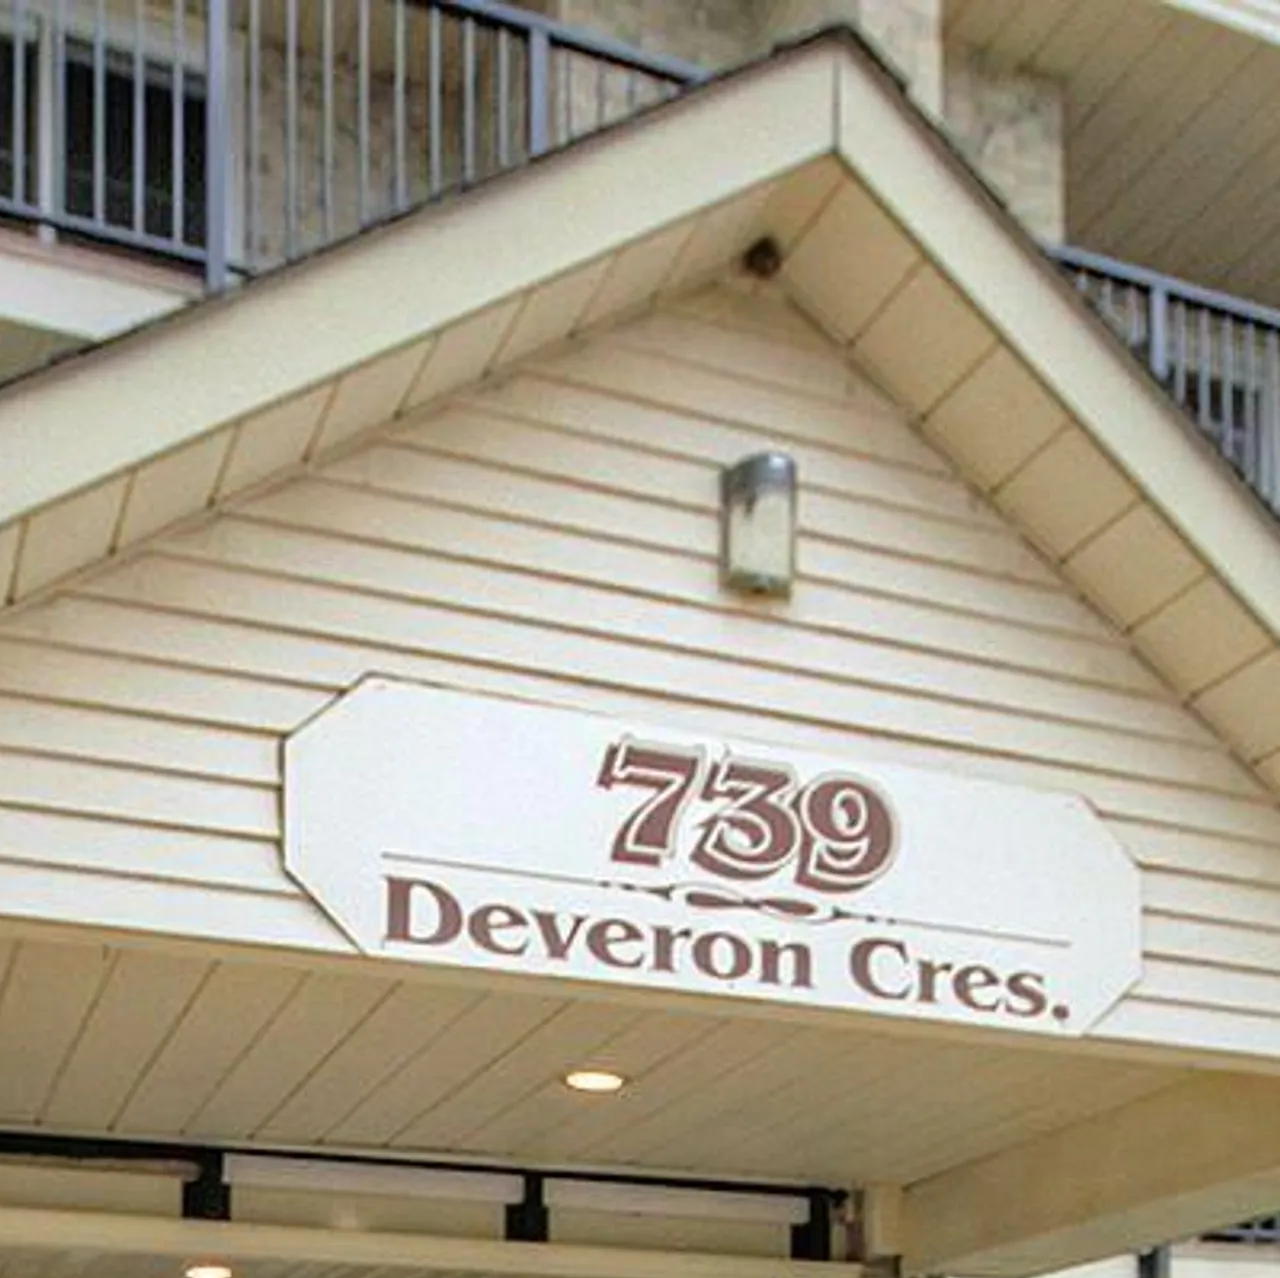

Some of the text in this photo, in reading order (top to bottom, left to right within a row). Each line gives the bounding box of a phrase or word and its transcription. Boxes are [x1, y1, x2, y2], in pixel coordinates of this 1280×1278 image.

[596, 735, 900, 894] 739
[384, 875, 1070, 1020] Deveron Cres.
